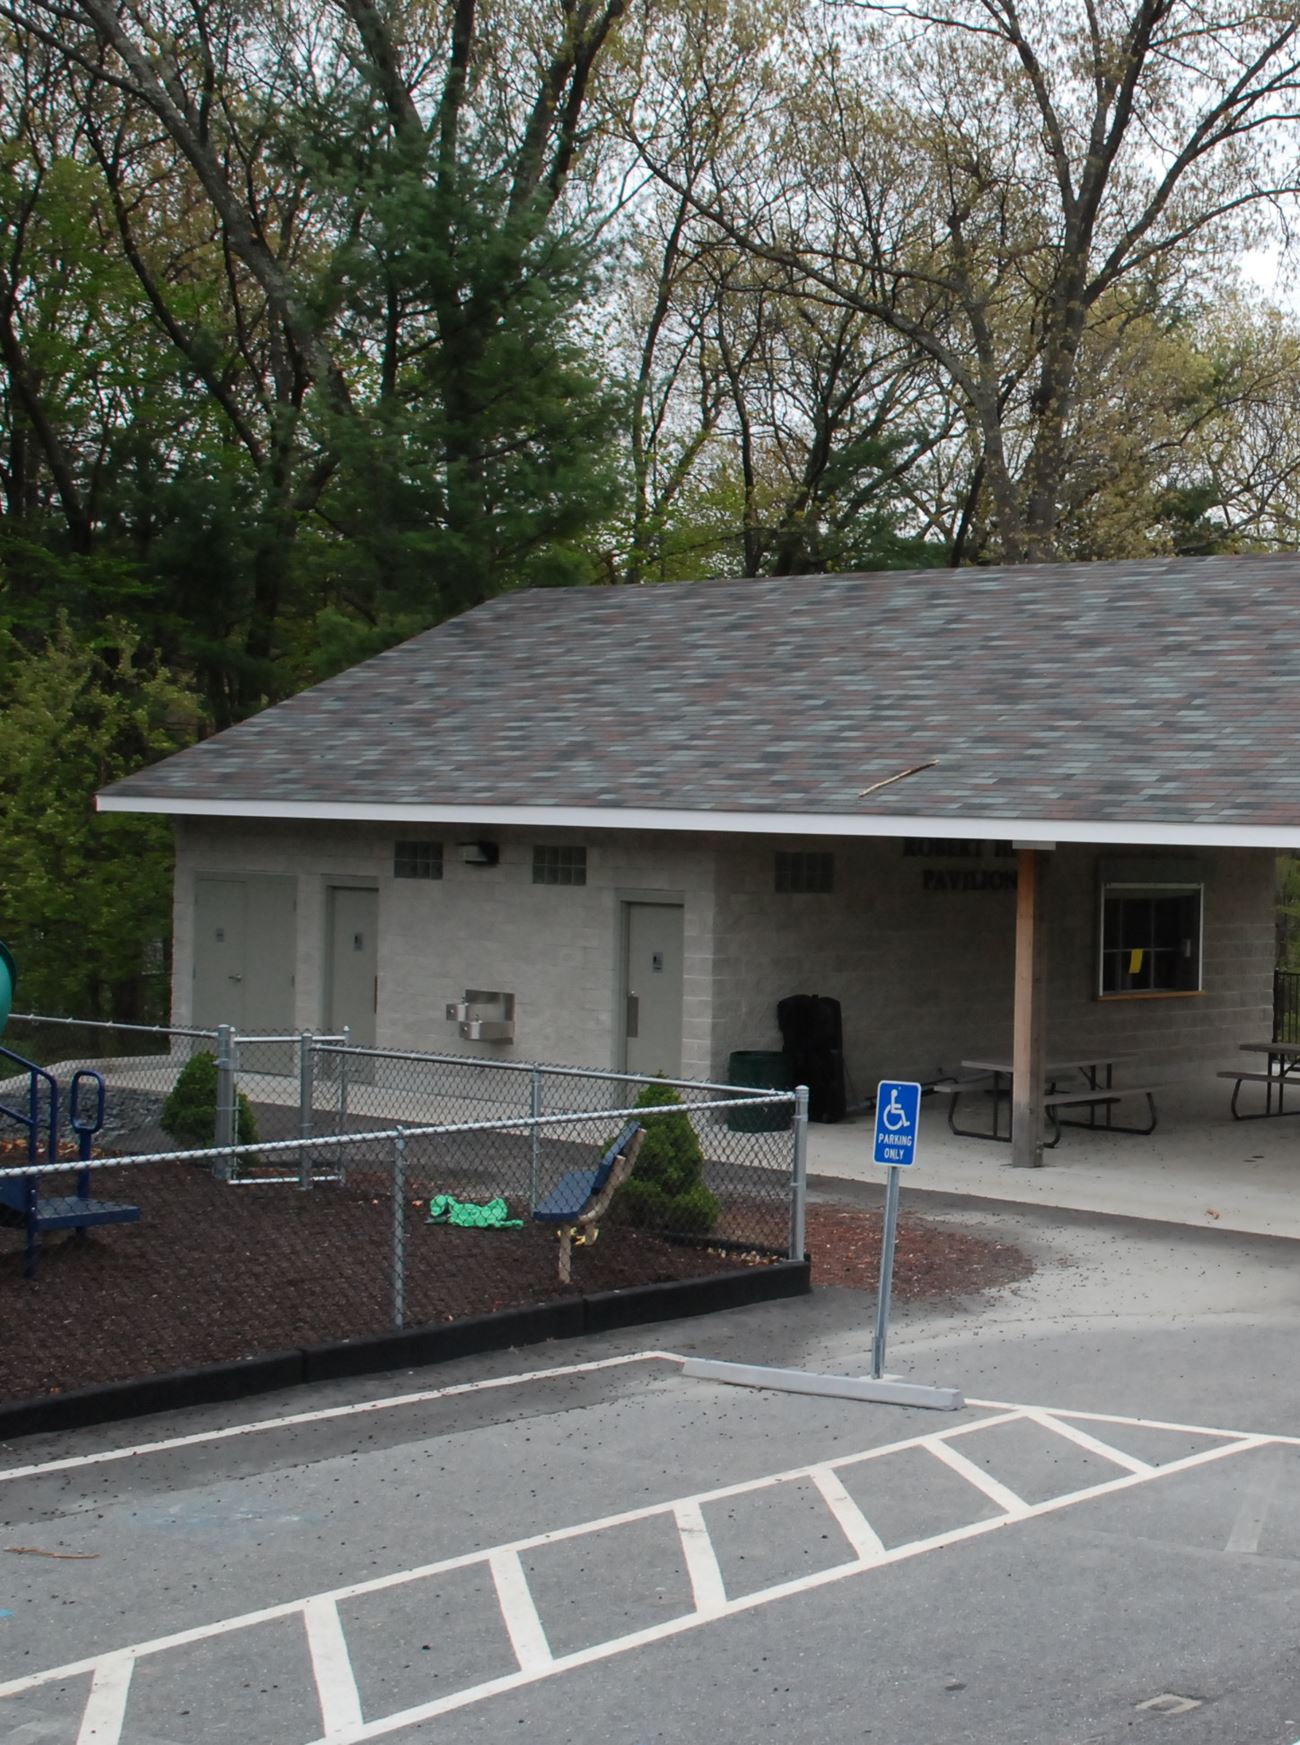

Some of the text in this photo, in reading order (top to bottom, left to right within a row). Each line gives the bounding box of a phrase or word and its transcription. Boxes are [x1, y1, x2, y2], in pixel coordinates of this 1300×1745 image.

[923, 869, 1018, 890] PAVILION
[878, 1133, 912, 1146] PARKING
[884, 1148, 904, 1160] ONLY
